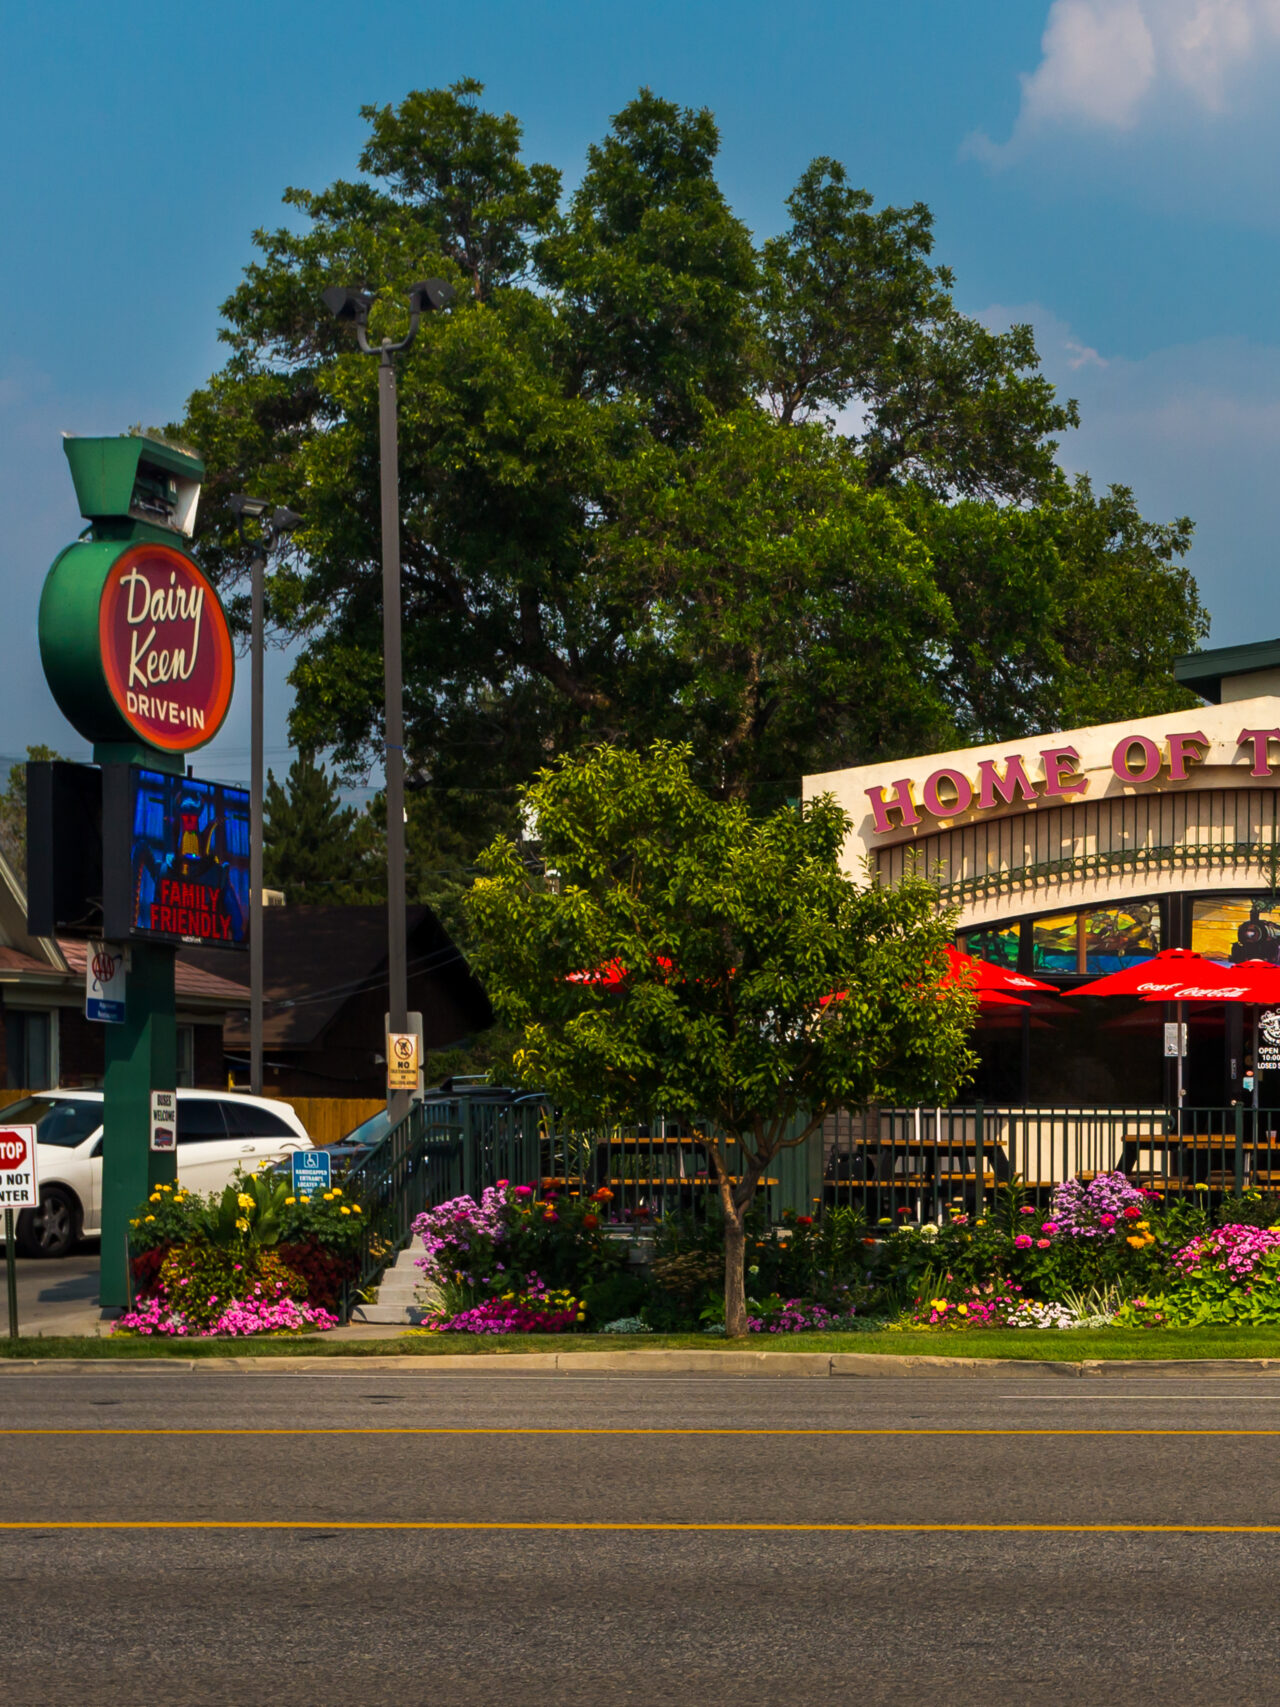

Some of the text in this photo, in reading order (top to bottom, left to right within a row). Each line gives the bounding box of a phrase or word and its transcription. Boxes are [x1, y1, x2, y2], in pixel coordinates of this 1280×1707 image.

[119, 567, 204, 660] Dairy
[128, 626, 188, 688] Keen
[864, 745, 1091, 834] HOME
[1111, 730, 1211, 784] OF
[161, 879, 220, 912] FAMILY
[150, 903, 232, 940] FRIENDLY
[397, 1061, 410, 1069] NO
[157, 1094, 172, 1106] BUSES
[153, 1109, 175, 1122] WELCOME
[0, 1141, 24, 1160] TOP
[6, 1173, 31, 1185] NOT
[0, 1189, 29, 1202] NTER
